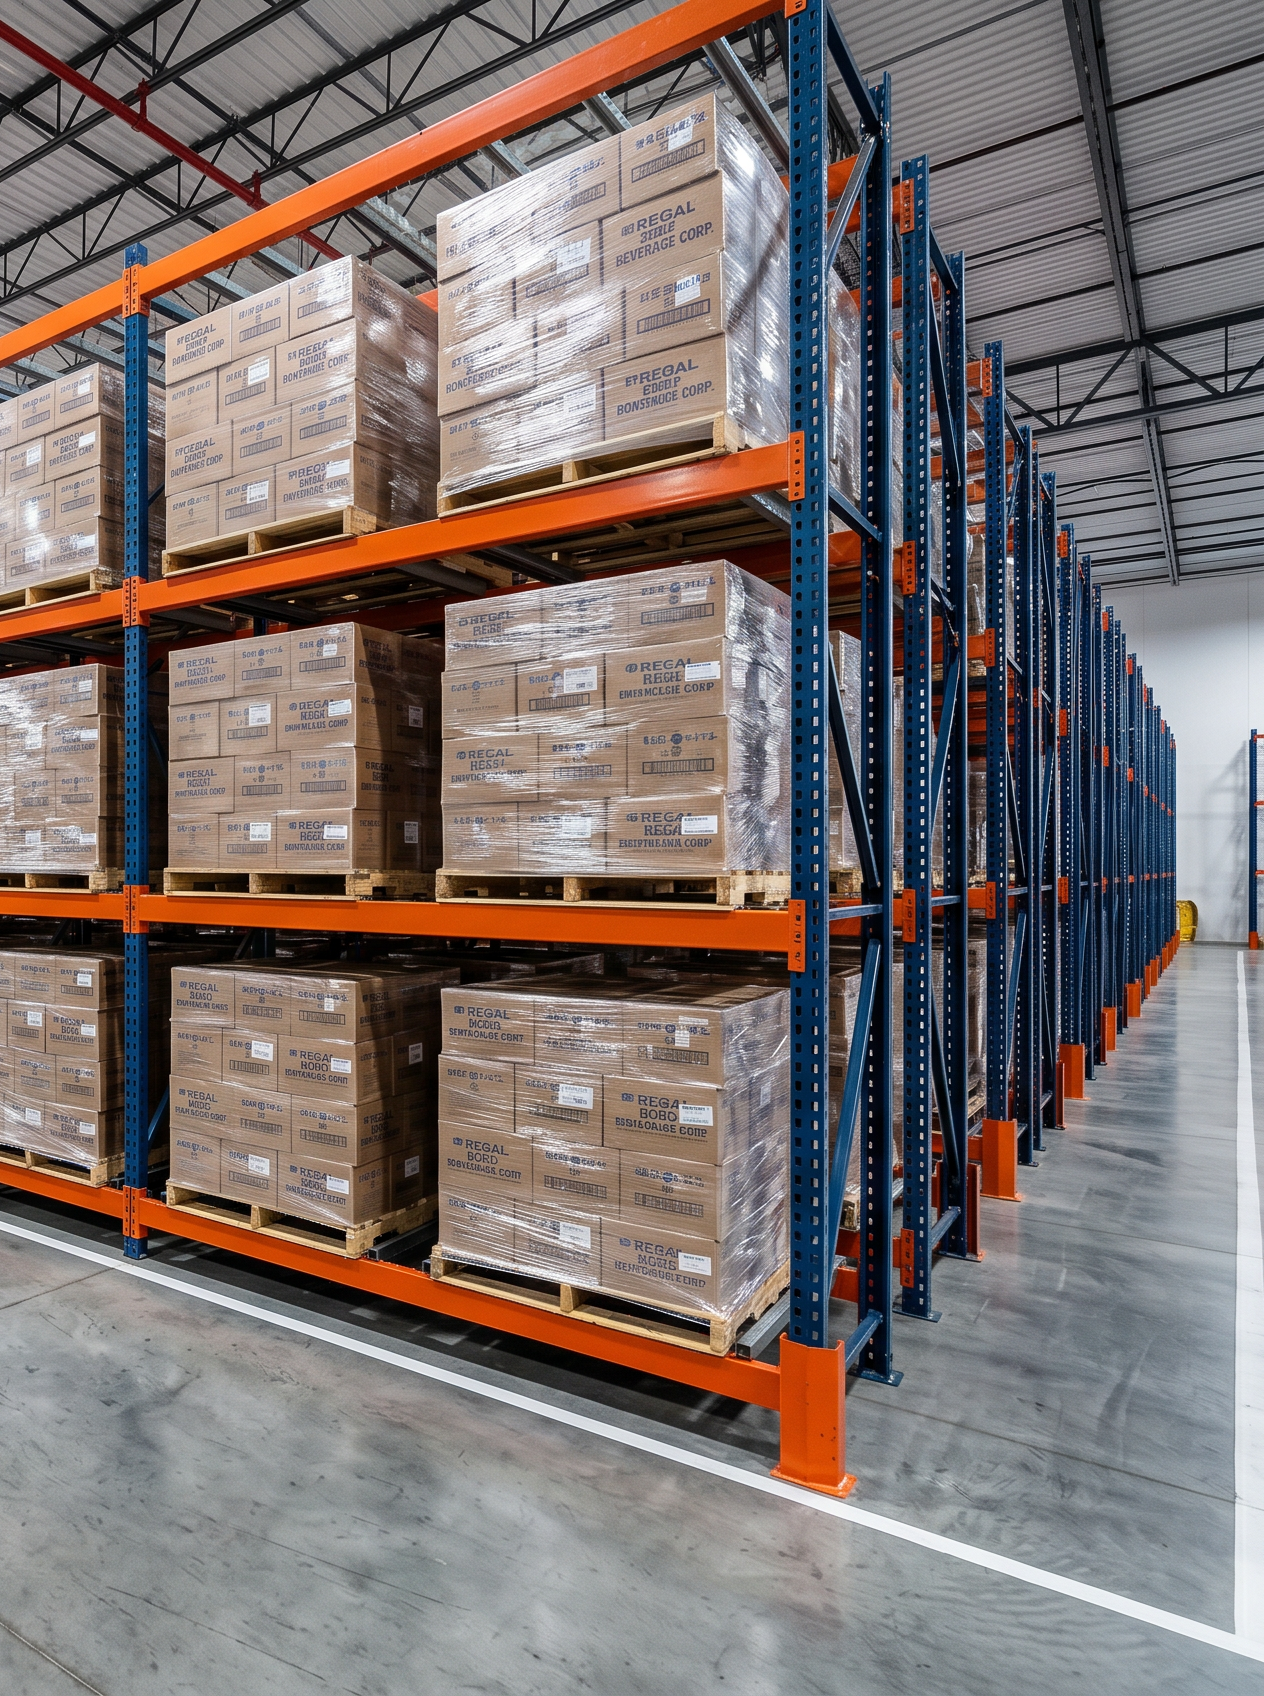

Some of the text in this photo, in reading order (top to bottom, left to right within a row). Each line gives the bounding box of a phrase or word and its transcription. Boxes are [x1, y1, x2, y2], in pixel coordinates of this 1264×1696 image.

[637, 201, 695, 232] REGAL
[616, 222, 714, 267] BEVERAGE CORP.
[189, 982, 218, 992] REGAL
[467, 1006, 511, 1020] REGAL
[637, 1094, 687, 1110] REGA
[465, 1139, 509, 1156] REGAL
